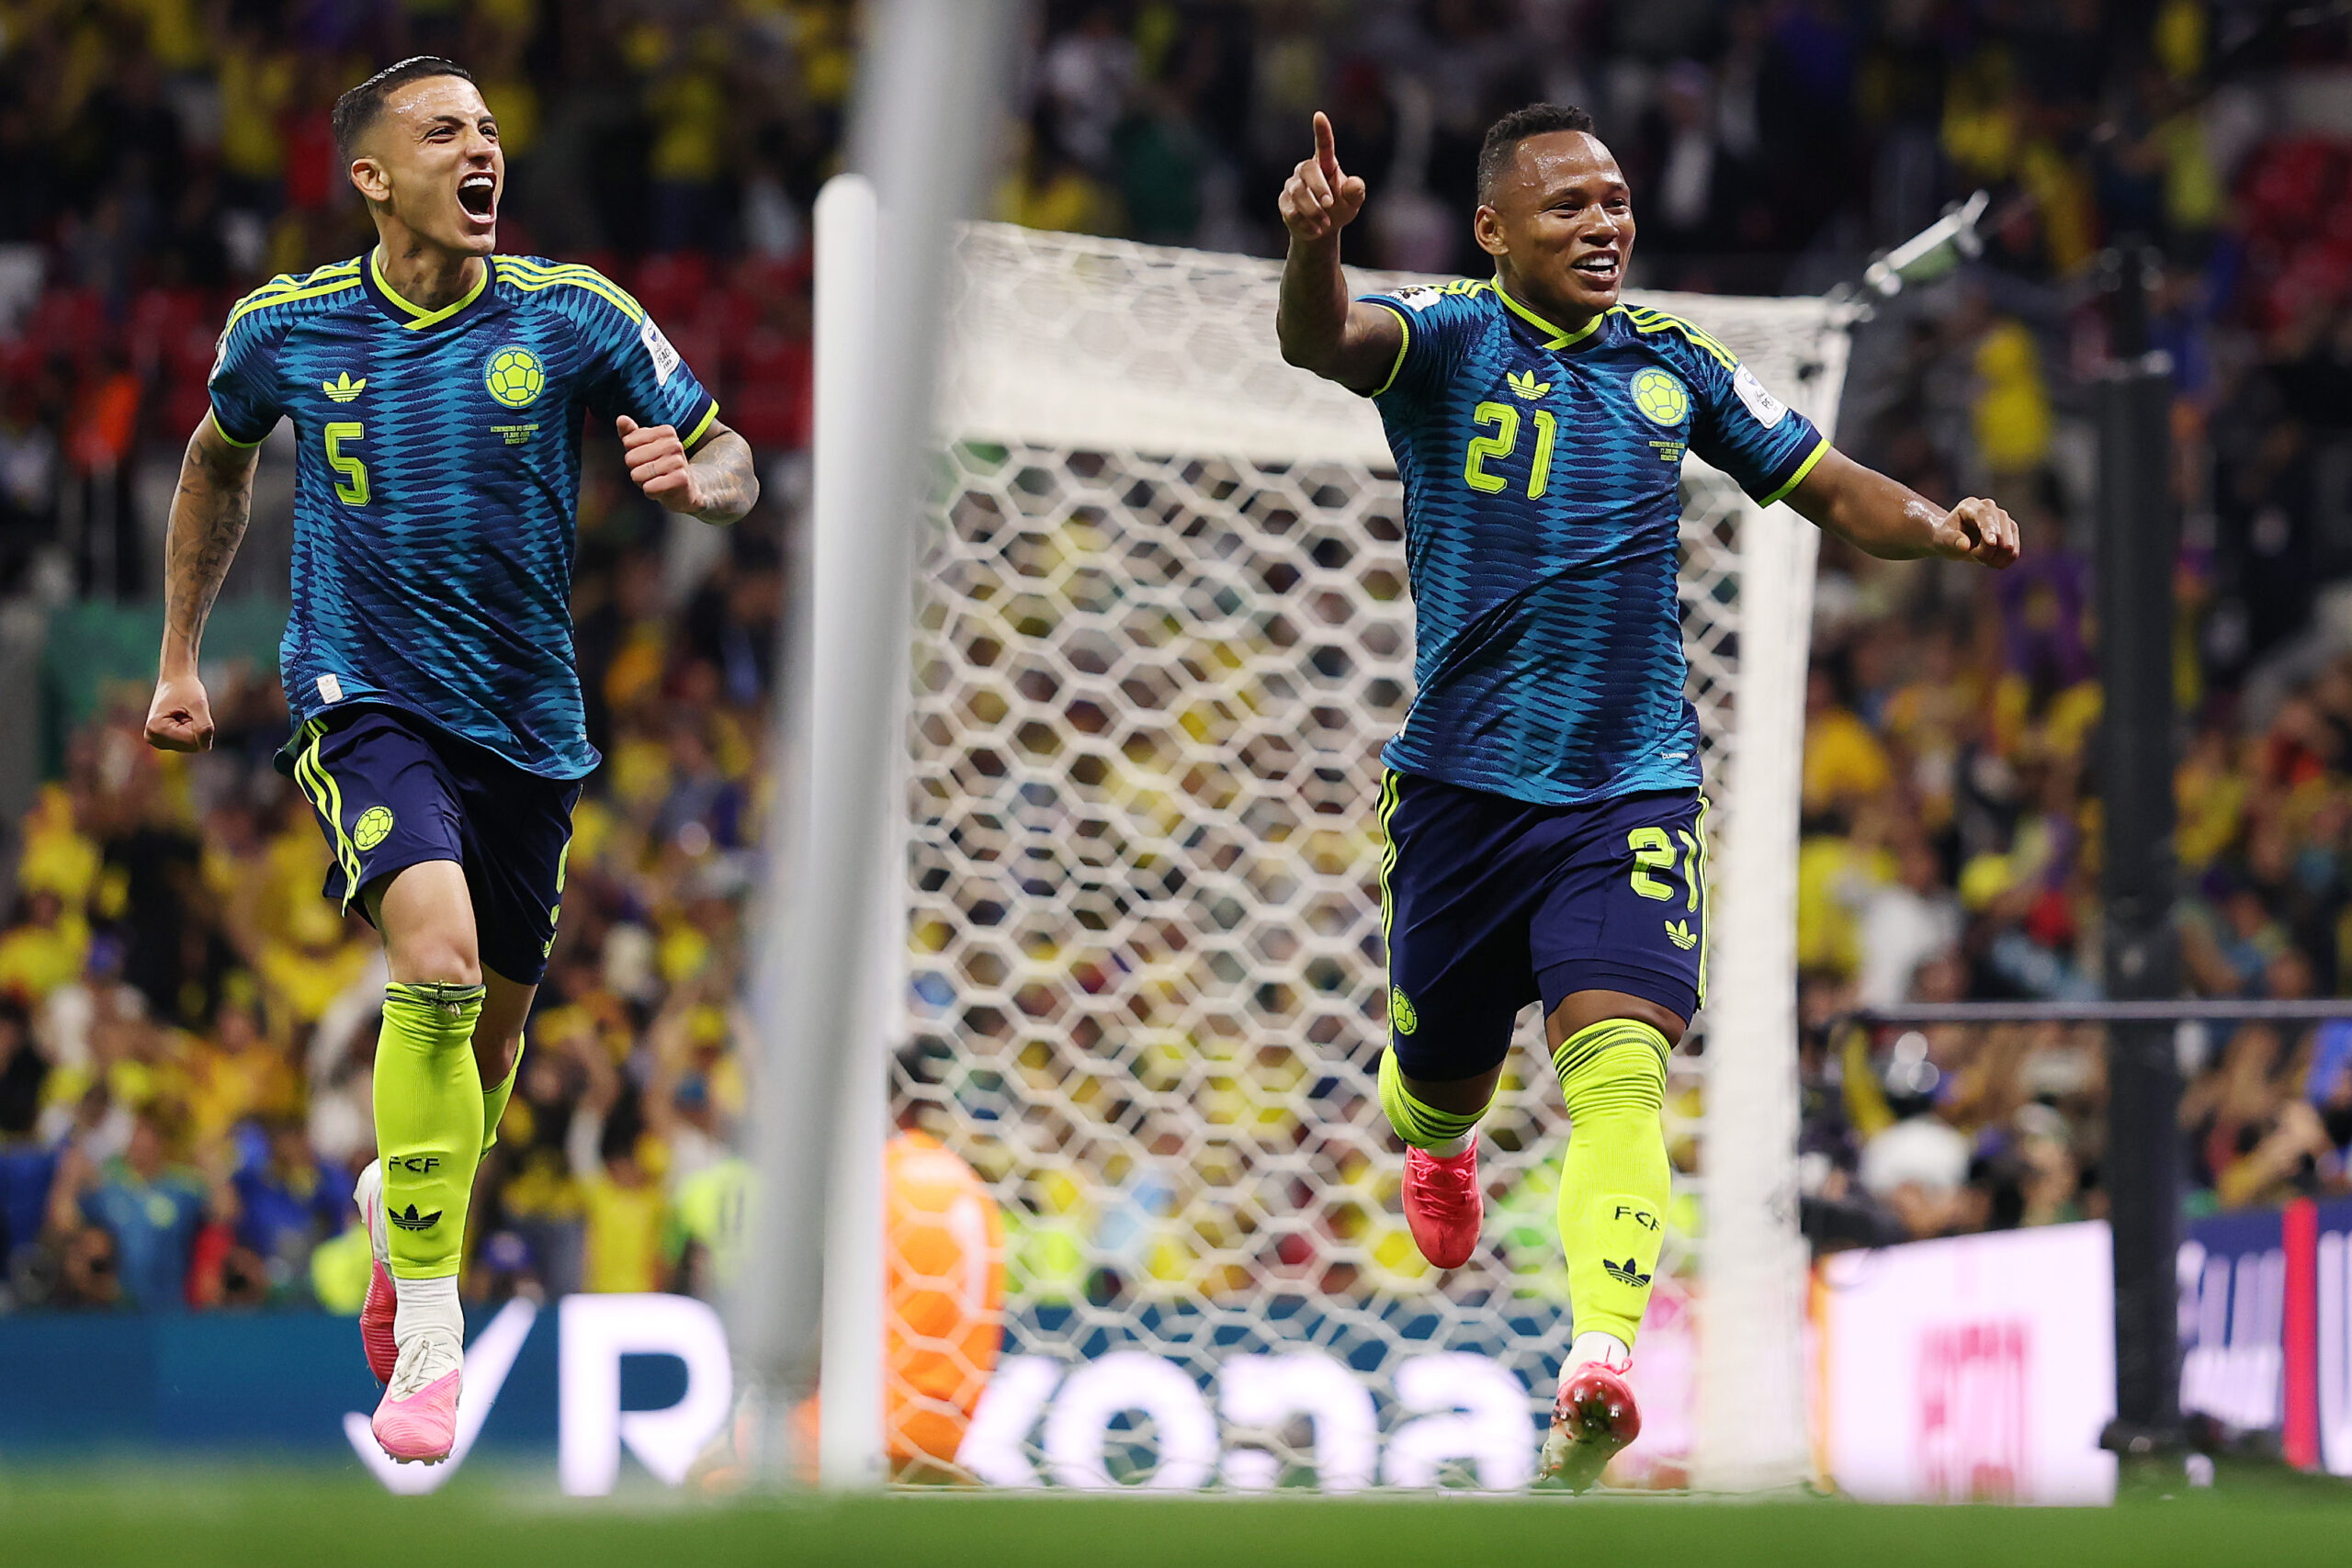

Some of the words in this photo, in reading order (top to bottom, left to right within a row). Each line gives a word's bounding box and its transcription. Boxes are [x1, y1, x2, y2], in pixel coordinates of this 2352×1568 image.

[323, 422, 371, 507] 5
[1464, 400, 1557, 501] 21
[1626, 827, 1700, 913] 21
[389, 1156, 440, 1173] FCF
[1614, 1205, 1660, 1232] FCF
